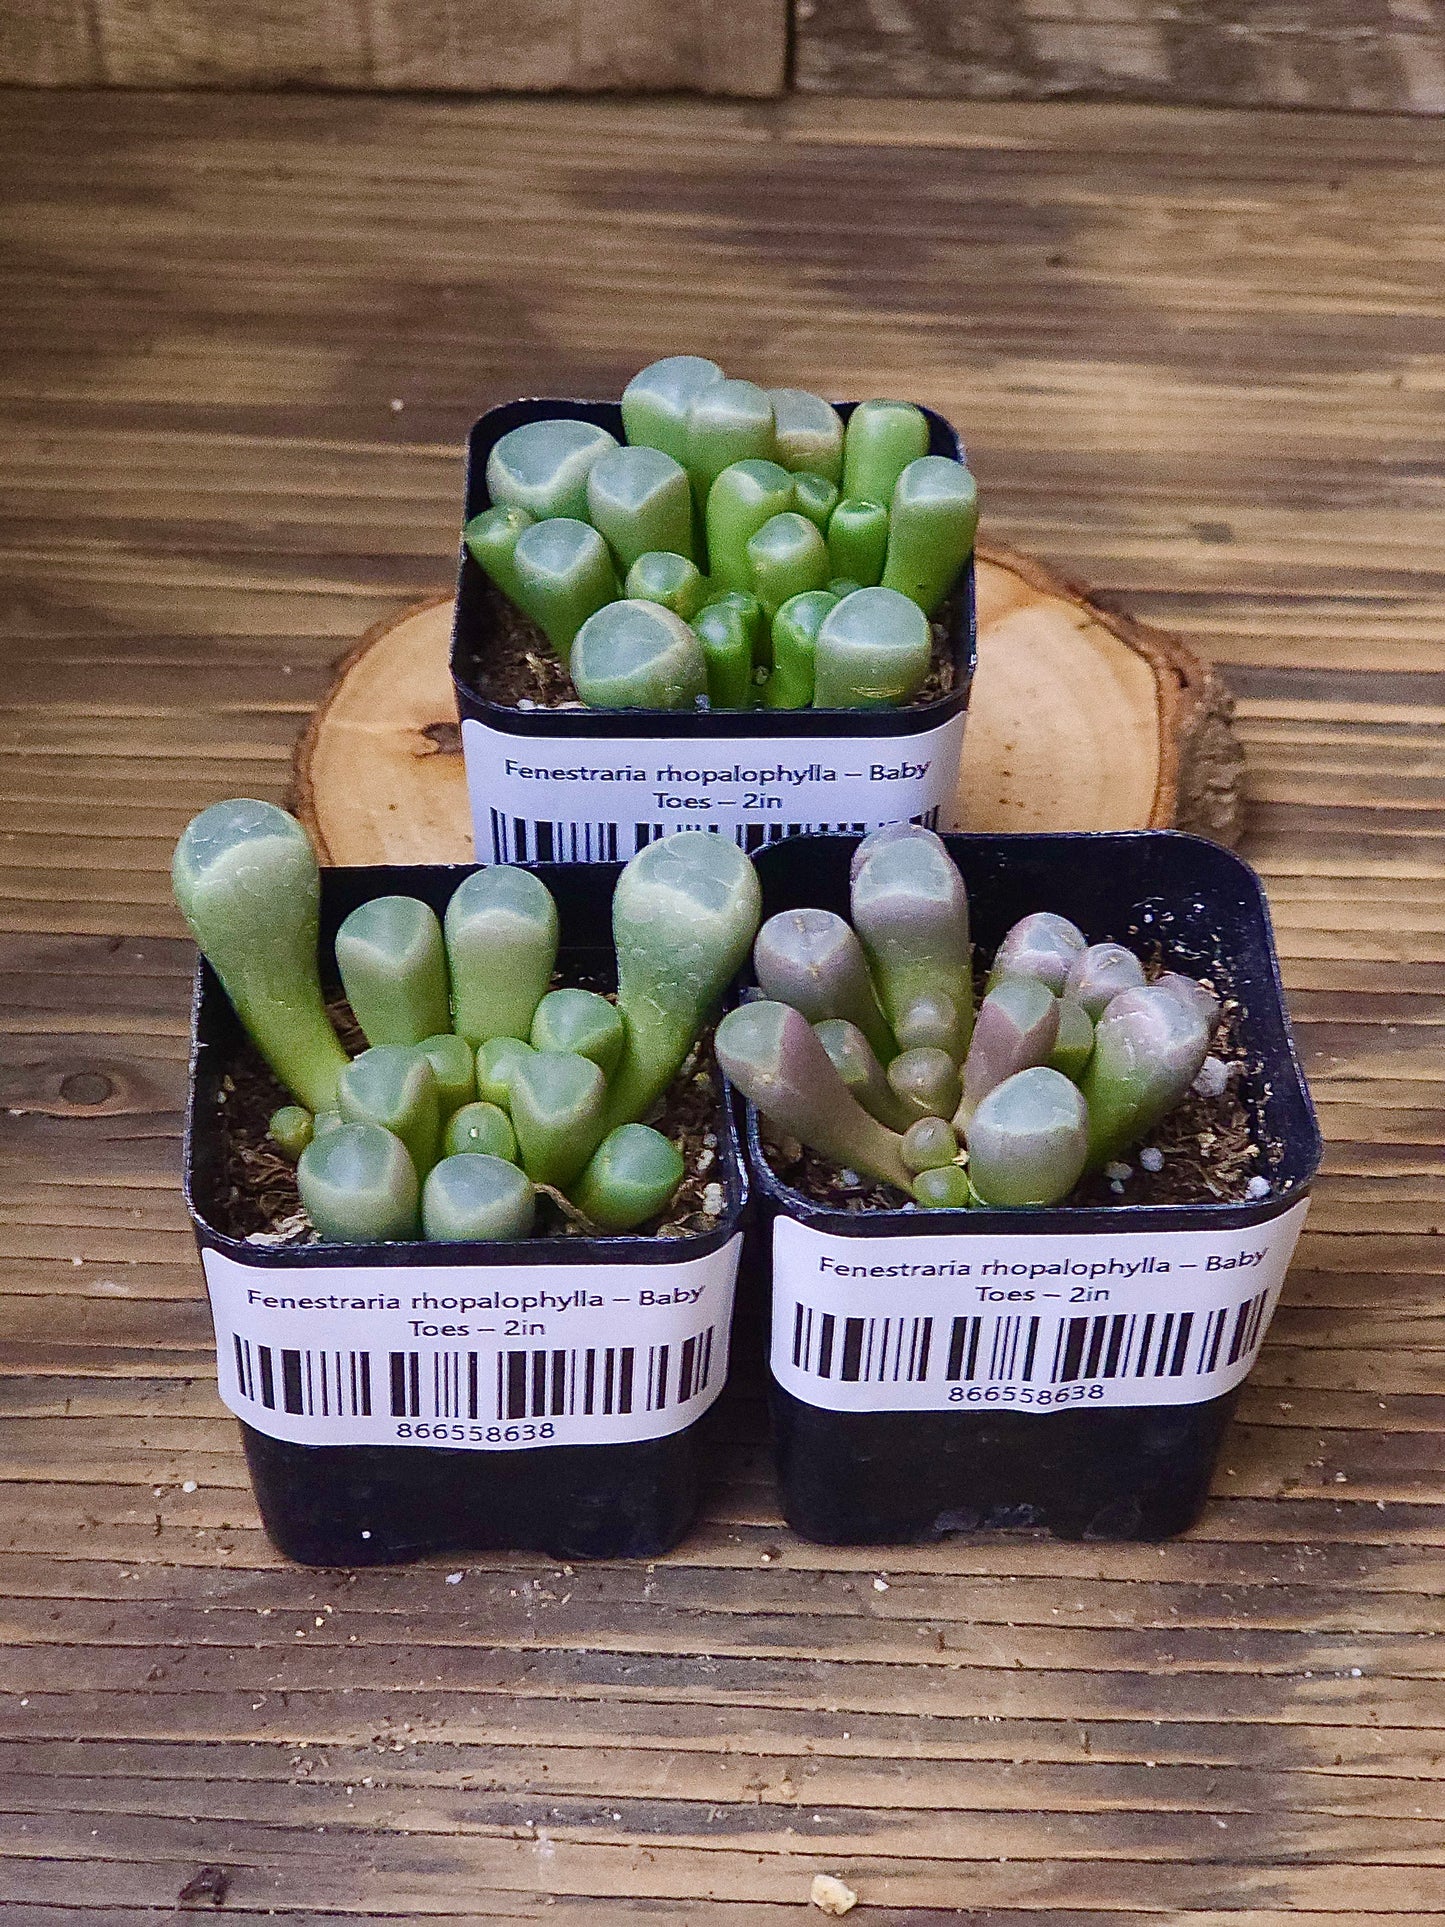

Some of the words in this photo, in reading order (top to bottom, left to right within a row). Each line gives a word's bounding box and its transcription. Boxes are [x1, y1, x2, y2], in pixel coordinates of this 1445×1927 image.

[504, 758, 647, 782] Fenestraria
[656, 763, 837, 787] rhopalophylla
[869, 760, 932, 782] Baby
[651, 791, 714, 810] Toes
[742, 792, 784, 810] 2in
[819, 1256, 973, 1278] Fenestraria
[980, 1256, 1171, 1280] rhopalophylla
[1205, 1246, 1269, 1273] Baby
[246, 1289, 401, 1310] Fenestraria
[411, 1289, 605, 1314] rhopalophylla
[638, 1284, 707, 1307] Baby
[974, 1285, 1037, 1302] Toes
[1068, 1285, 1111, 1303] 2in
[406, 1320, 471, 1337] Toes
[503, 1319, 547, 1337] 2in
[948, 1383, 1105, 1405] 866558638
[396, 1420, 556, 1442] 866558638
